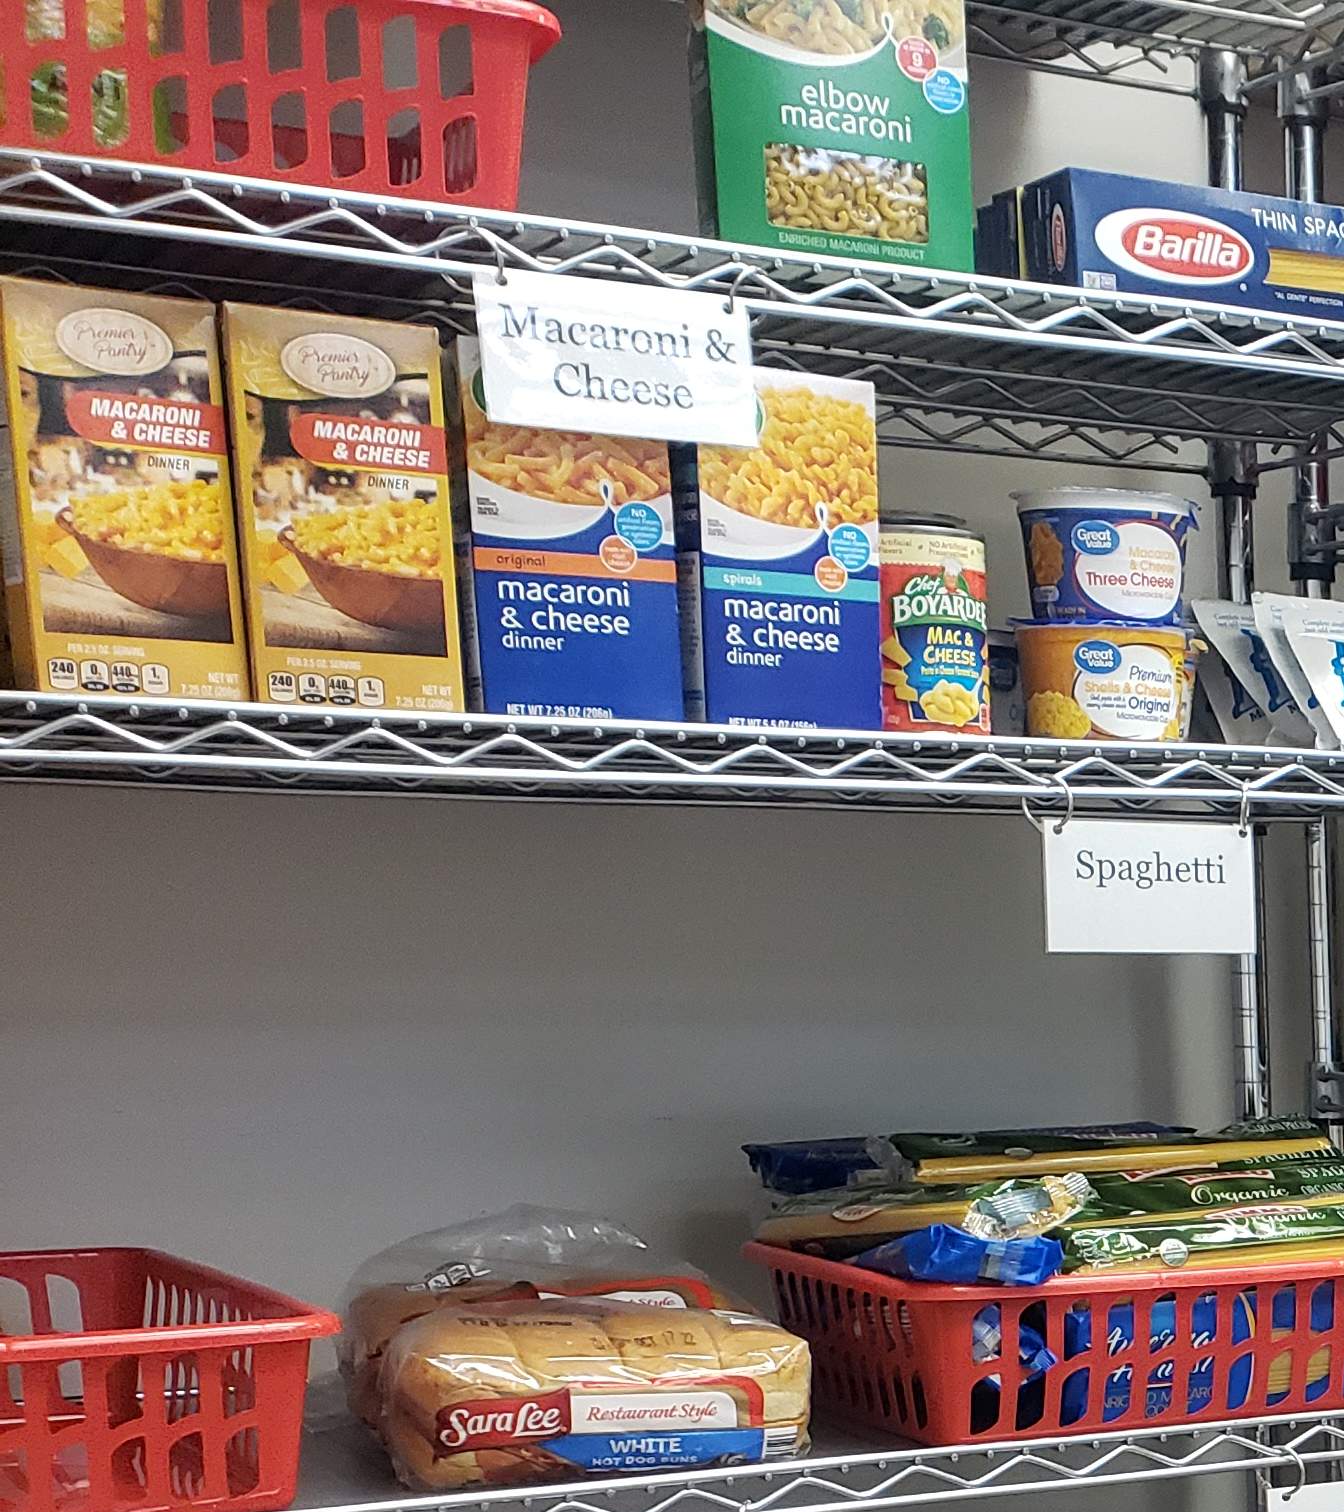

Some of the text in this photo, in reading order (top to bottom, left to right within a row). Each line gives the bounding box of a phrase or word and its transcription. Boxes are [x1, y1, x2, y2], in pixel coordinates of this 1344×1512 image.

[800, 79, 890, 118] elbow
[1251, 205, 1298, 235] THIN
[778, 231, 925, 259] ENRICHED PRODUCT
[1132, 224, 1242, 273] Barilla
[500, 302, 738, 364] Macaroni &
[552, 365, 695, 410] Cheese
[91, 398, 201, 426] MACARONI
[133, 424, 210, 447] CHEESE
[312, 420, 421, 447] MACARONI
[146, 455, 191, 472] DINNER
[354, 446, 430, 468] CHEESE
[367, 475, 409, 491] DINNER
[496, 554, 546, 569] original
[723, 573, 762, 588] spirals
[905, 575, 940, 595] Chef
[1086, 571, 1174, 589] Three Cheese
[498, 580, 630, 606] macaroni
[501, 604, 630, 635] & cheese
[724, 598, 840, 625] macaroni
[501, 632, 564, 651] dinner
[726, 623, 840, 653] & cheese
[927, 626, 962, 644] MAC
[726, 649, 782, 667] dinner
[1129, 696, 1170, 713] Original
[1075, 849, 1227, 889] Spaghetti
[1190, 1184, 1290, 1205] Organic
[586, 1399, 719, 1421] Restaurant Style
[609, 1437, 683, 1455] WHITE
[625, 1455, 656, 1465] DOG
